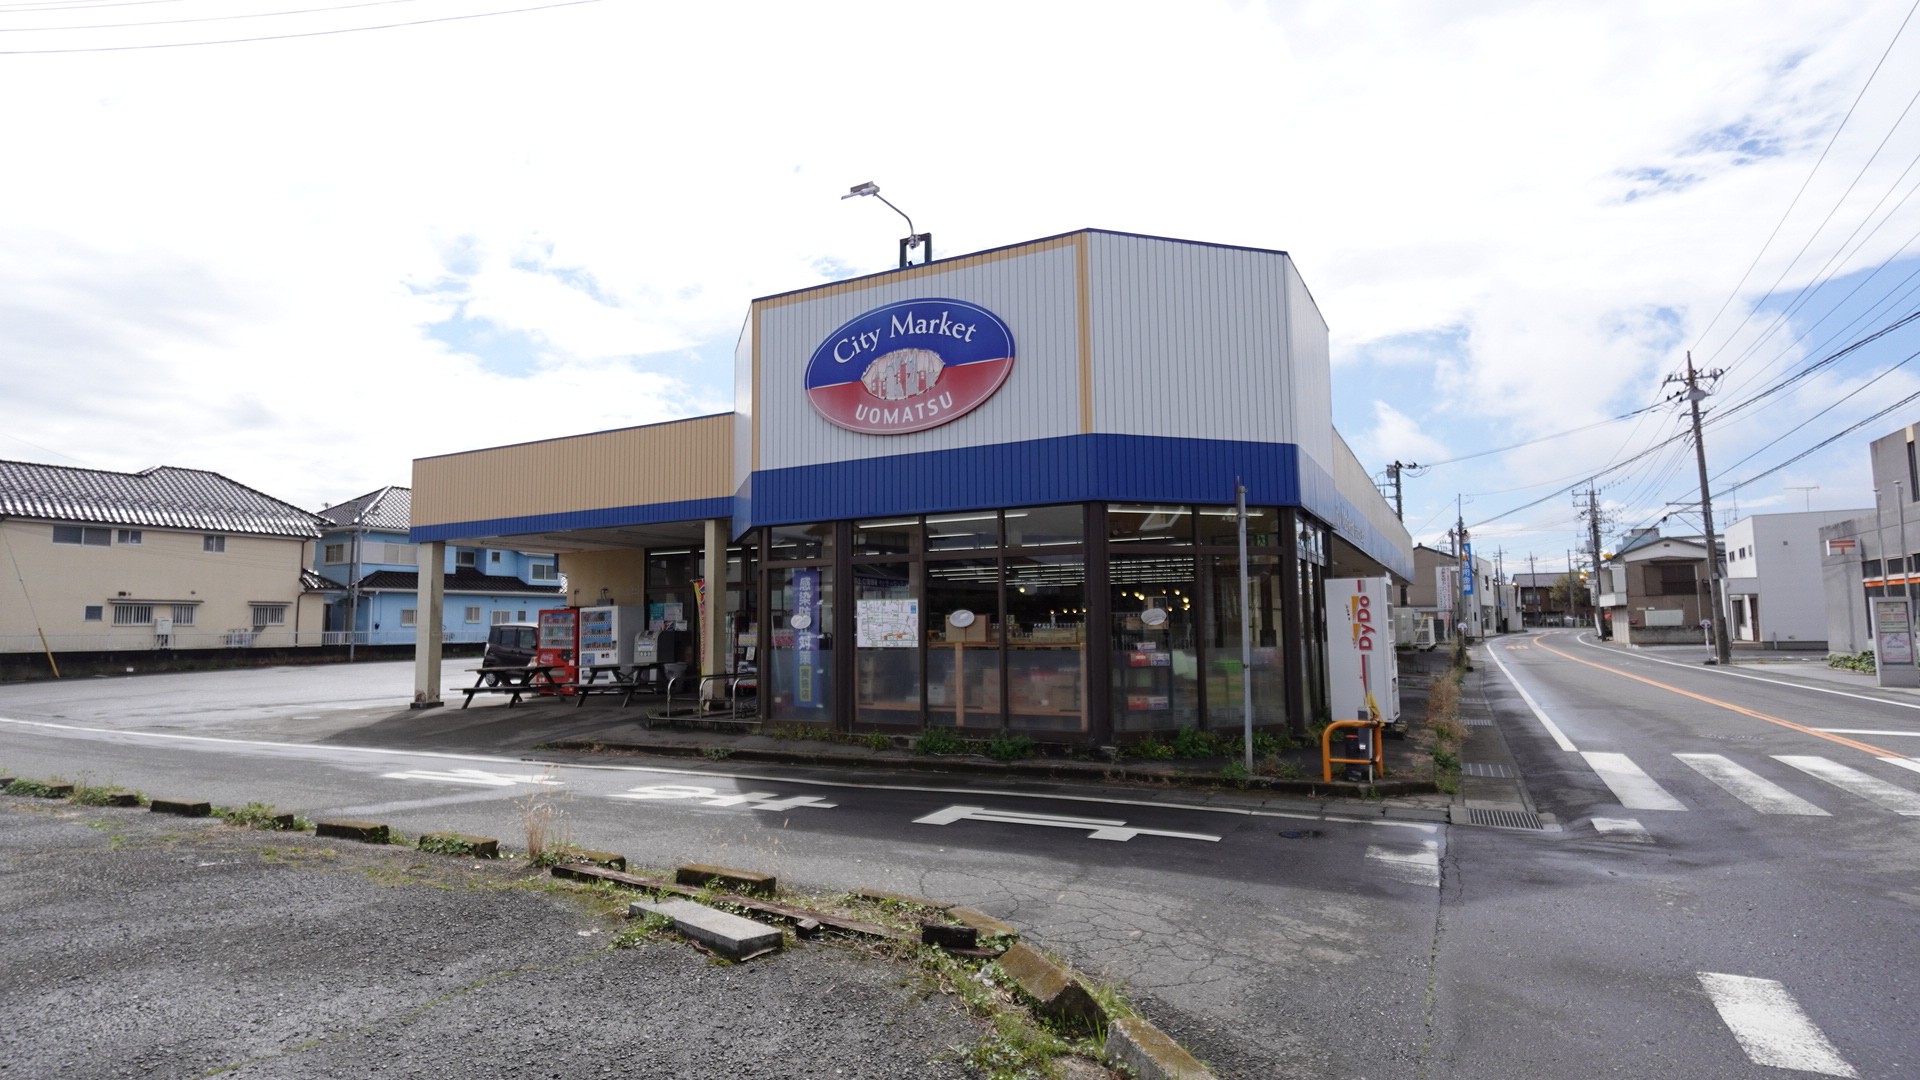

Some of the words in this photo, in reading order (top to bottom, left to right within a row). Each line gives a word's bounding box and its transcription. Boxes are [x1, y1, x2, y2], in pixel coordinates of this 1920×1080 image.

[833, 328, 881, 363] City
[890, 311, 977, 343] Market
[855, 391, 953, 424] UOMATSU
[1358, 595, 1376, 650] DyDo
